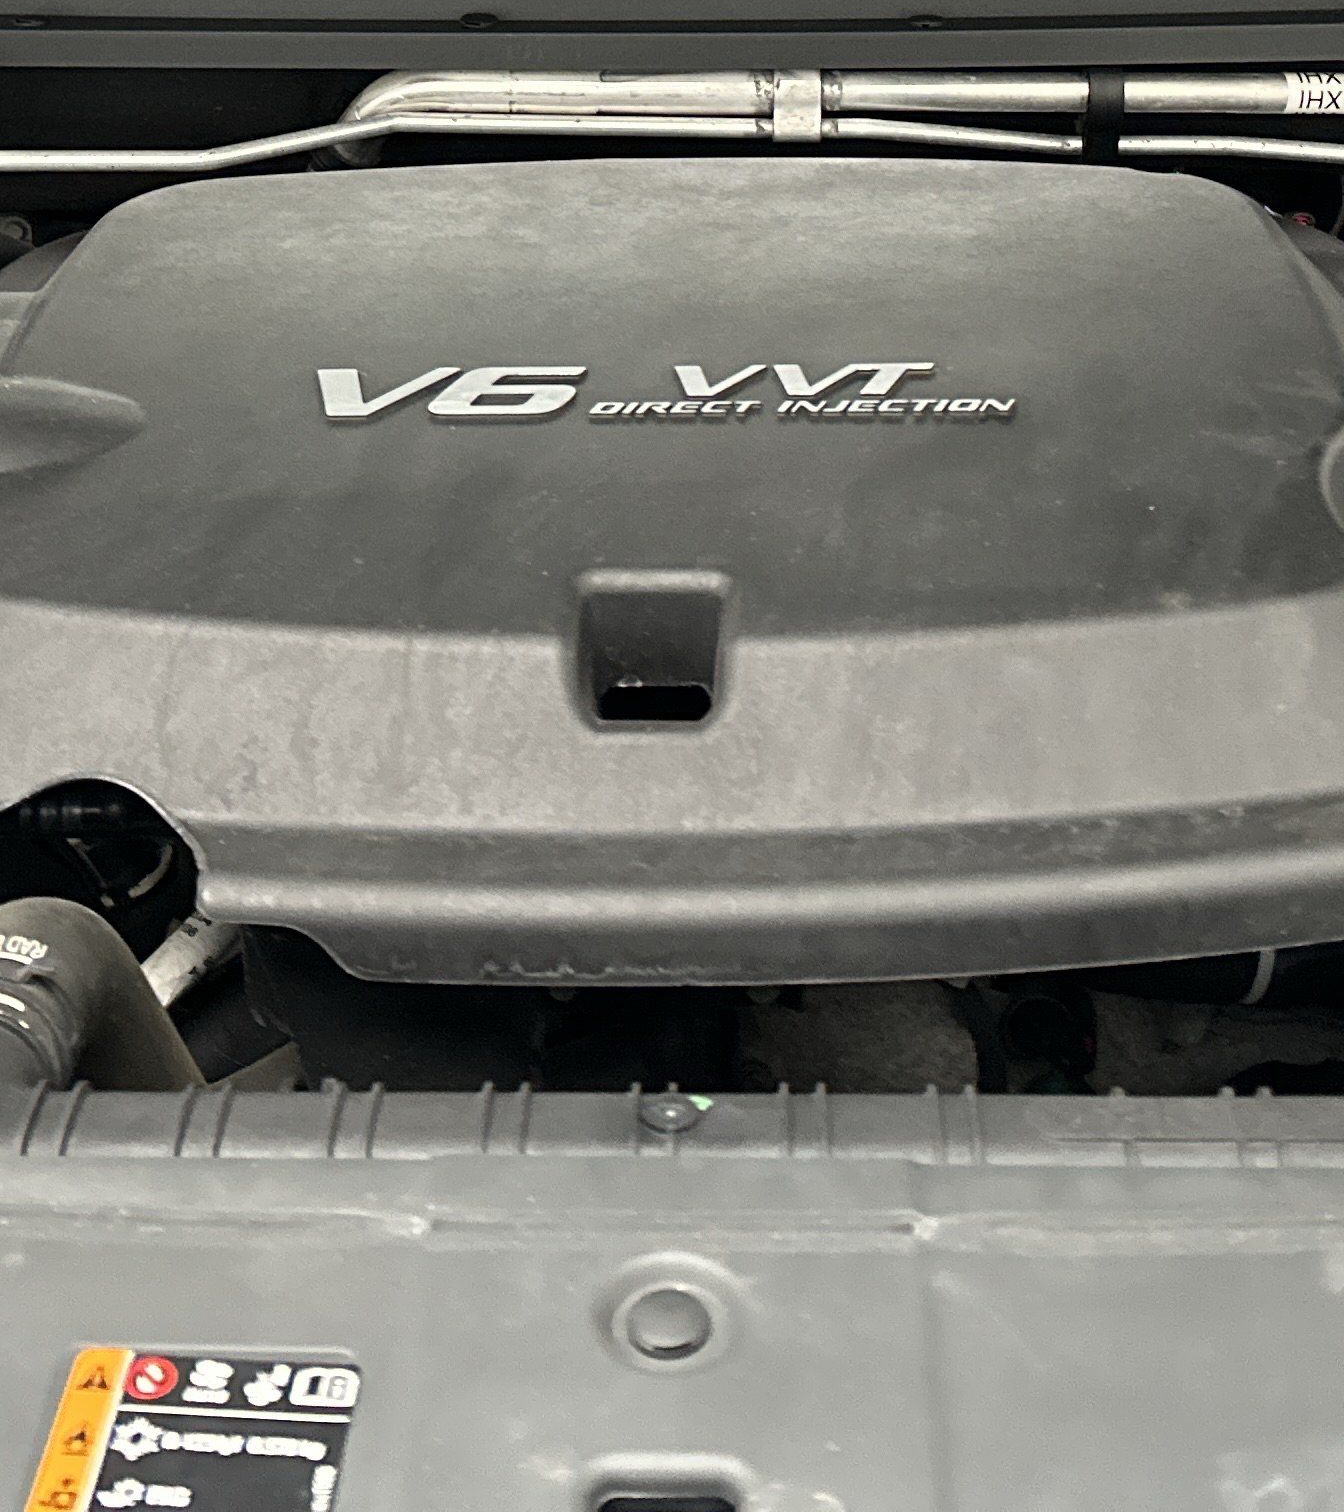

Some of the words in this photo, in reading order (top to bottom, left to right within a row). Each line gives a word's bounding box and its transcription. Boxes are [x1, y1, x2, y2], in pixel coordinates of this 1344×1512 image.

[1298, 90, 1343, 110] IHX
[316, 365, 587, 418] V6
[673, 361, 936, 398] VVT
[588, 399, 763, 417] DIRECT
[776, 397, 1017, 418] INJECTION
[6, 935, 49, 960] RAD
